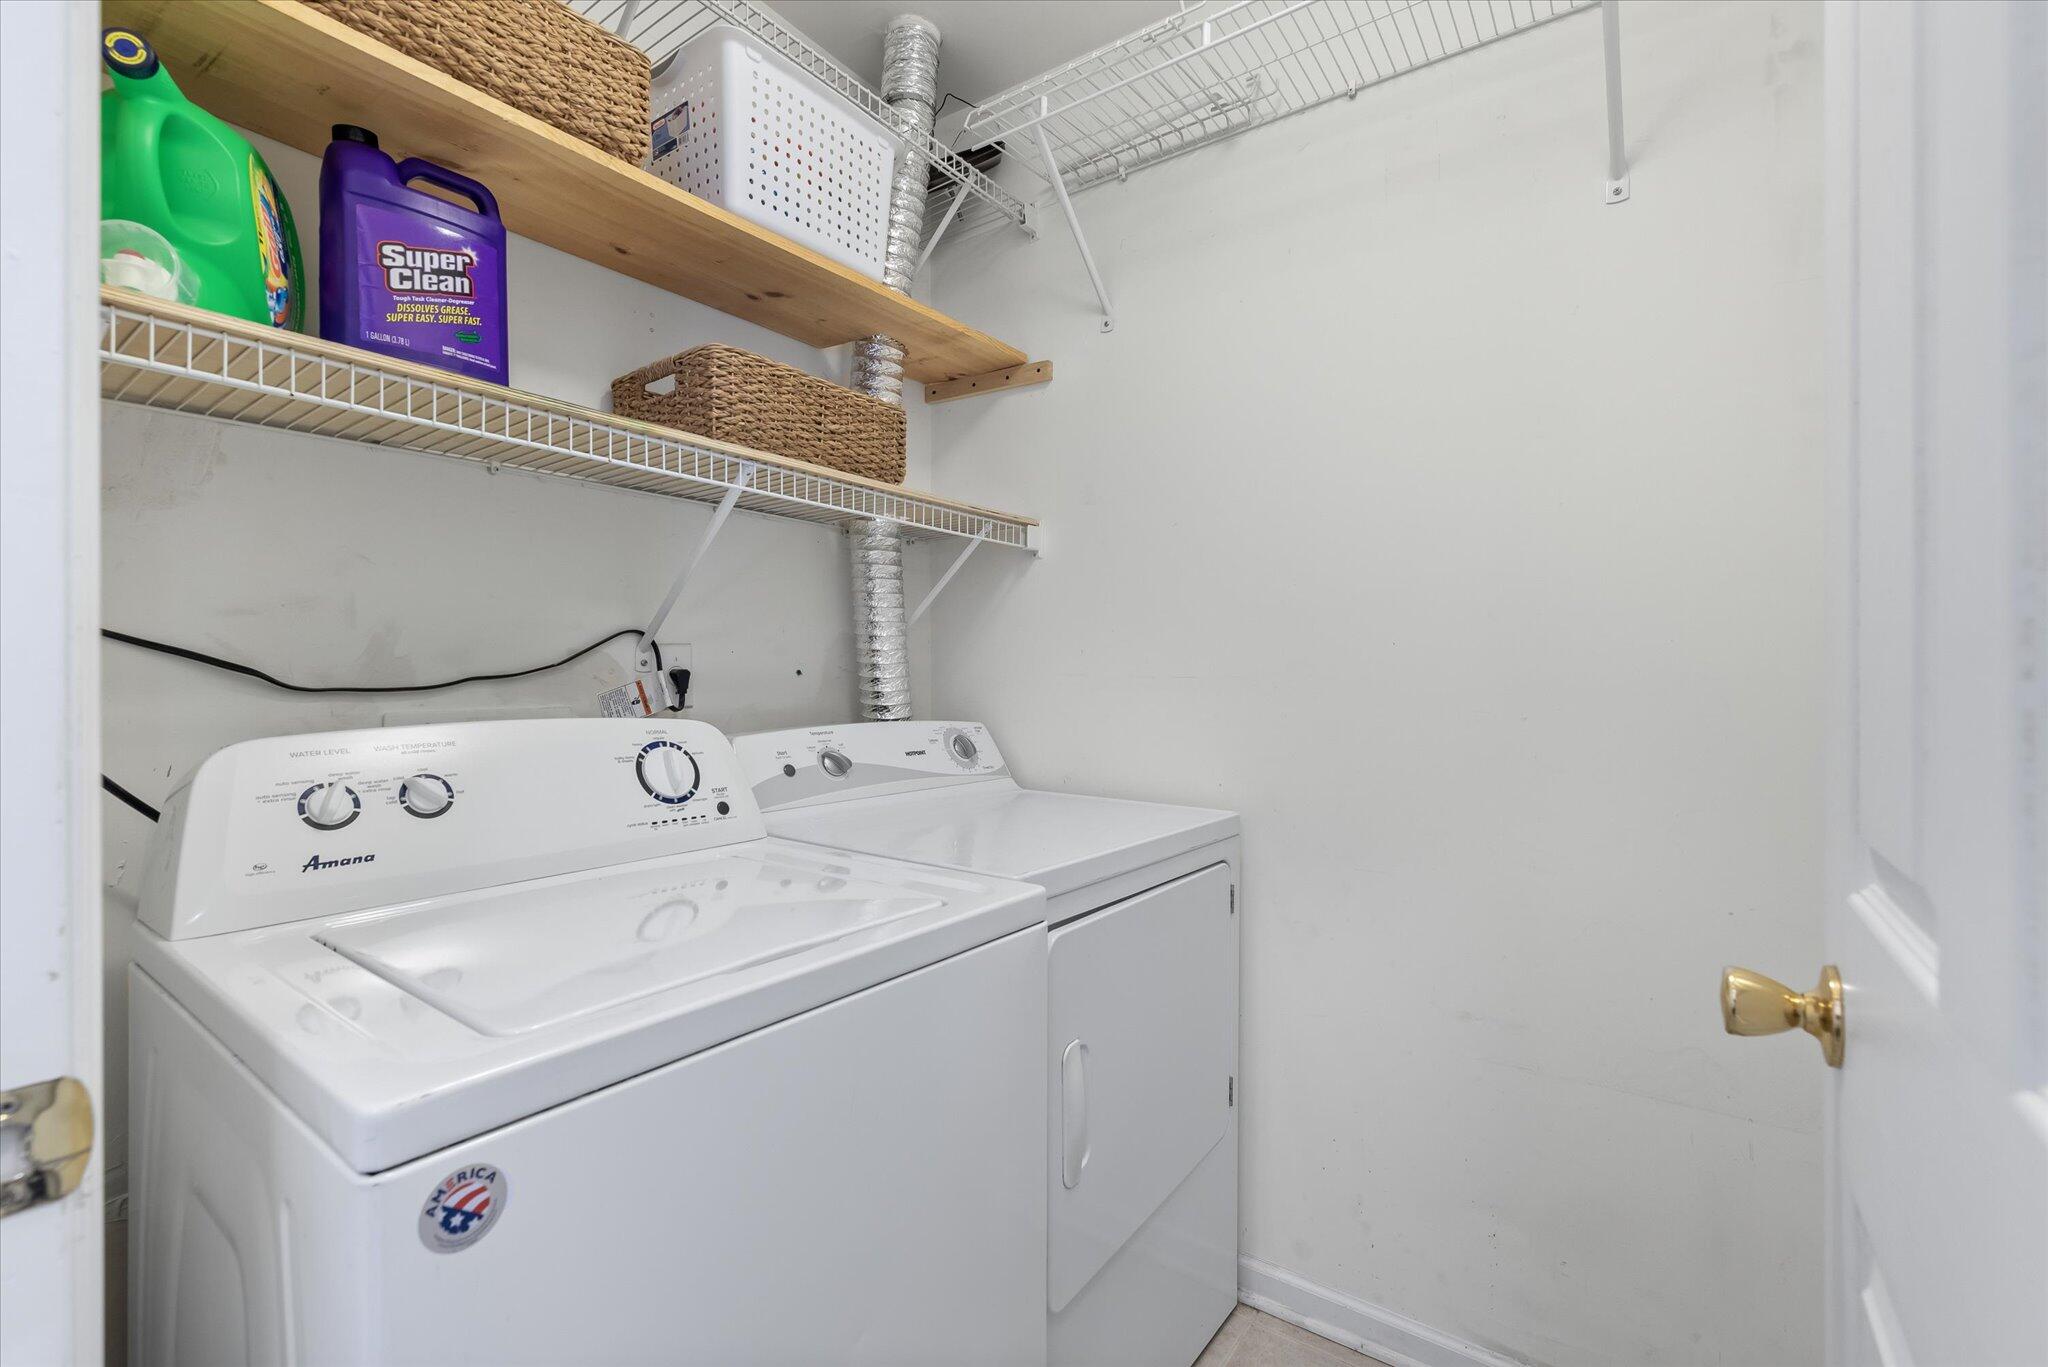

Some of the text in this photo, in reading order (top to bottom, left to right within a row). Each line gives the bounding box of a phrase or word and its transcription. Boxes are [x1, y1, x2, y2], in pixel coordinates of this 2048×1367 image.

[381, 244, 471, 273] Super
[389, 267, 470, 294] Clean
[393, 295, 411, 303] Tough
[397, 303, 471, 316] DISSOLVES GREASE.
[386, 313, 482, 326] SUPER EASY. SUPER FAST.
[370, 331, 391, 343] GALLON
[374, 740, 457, 752] WASH TEMPERATURE
[289, 748, 351, 759] WATER LEVEL
[711, 786, 728, 794] START
[302, 854, 376, 873] Amana
[425, 1167, 497, 1218] AMERICA
